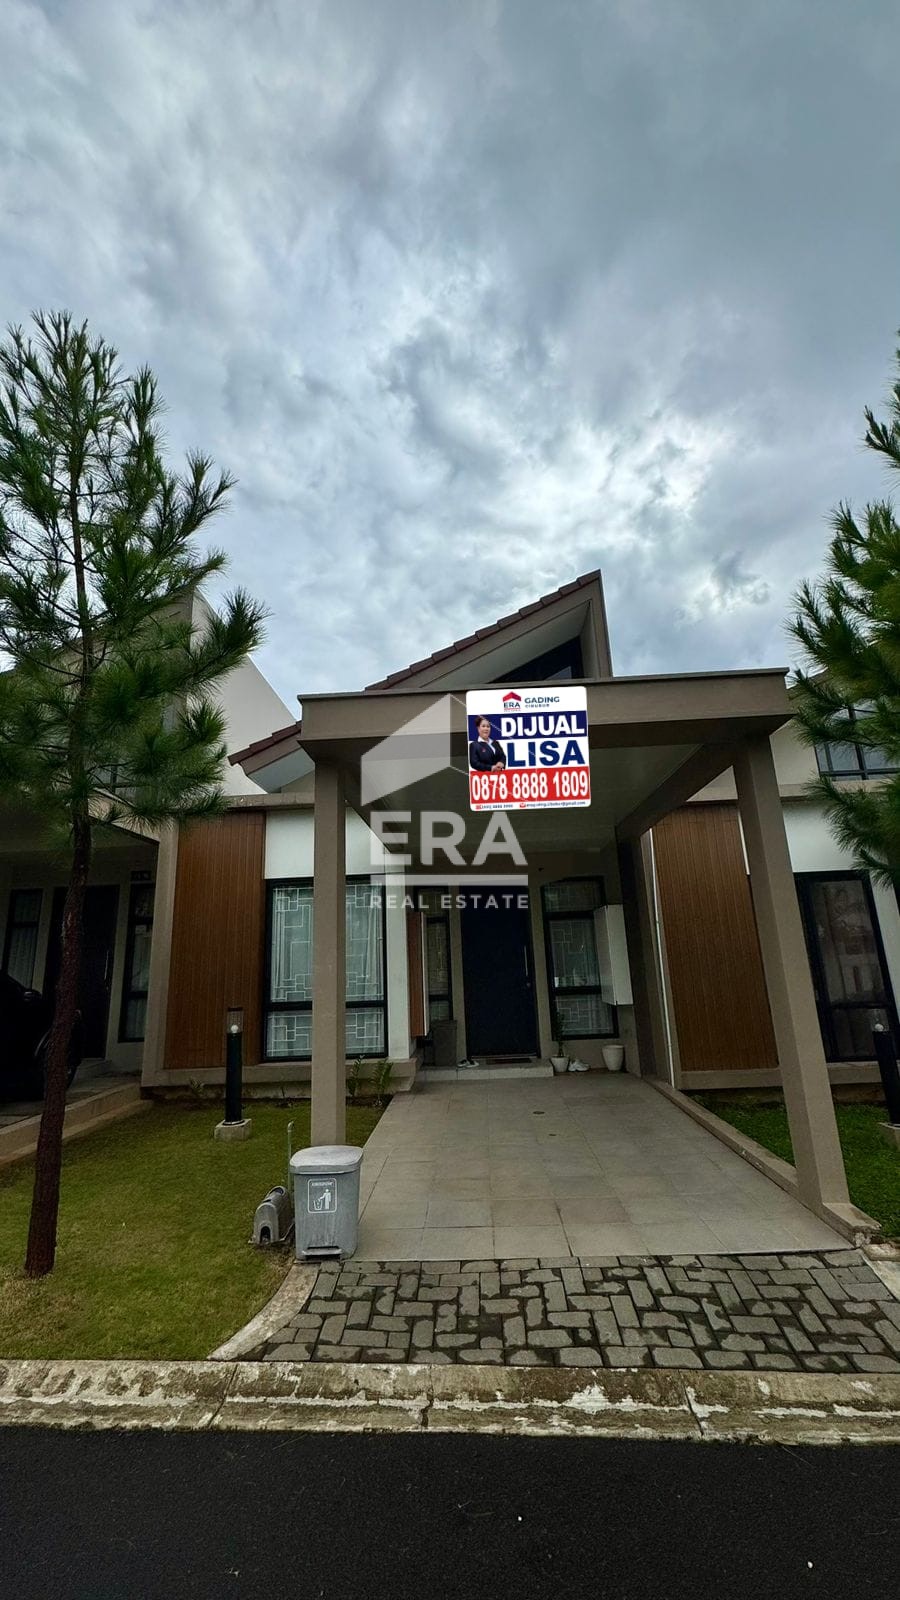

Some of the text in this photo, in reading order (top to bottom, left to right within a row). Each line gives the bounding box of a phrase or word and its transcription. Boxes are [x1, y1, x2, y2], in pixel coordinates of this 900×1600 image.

[524, 696, 560, 704] GADING
[501, 714, 585, 737] DIJUAL
[507, 740, 585, 768] LISA
[471, 770, 588, 800] 0878 8888 1809
